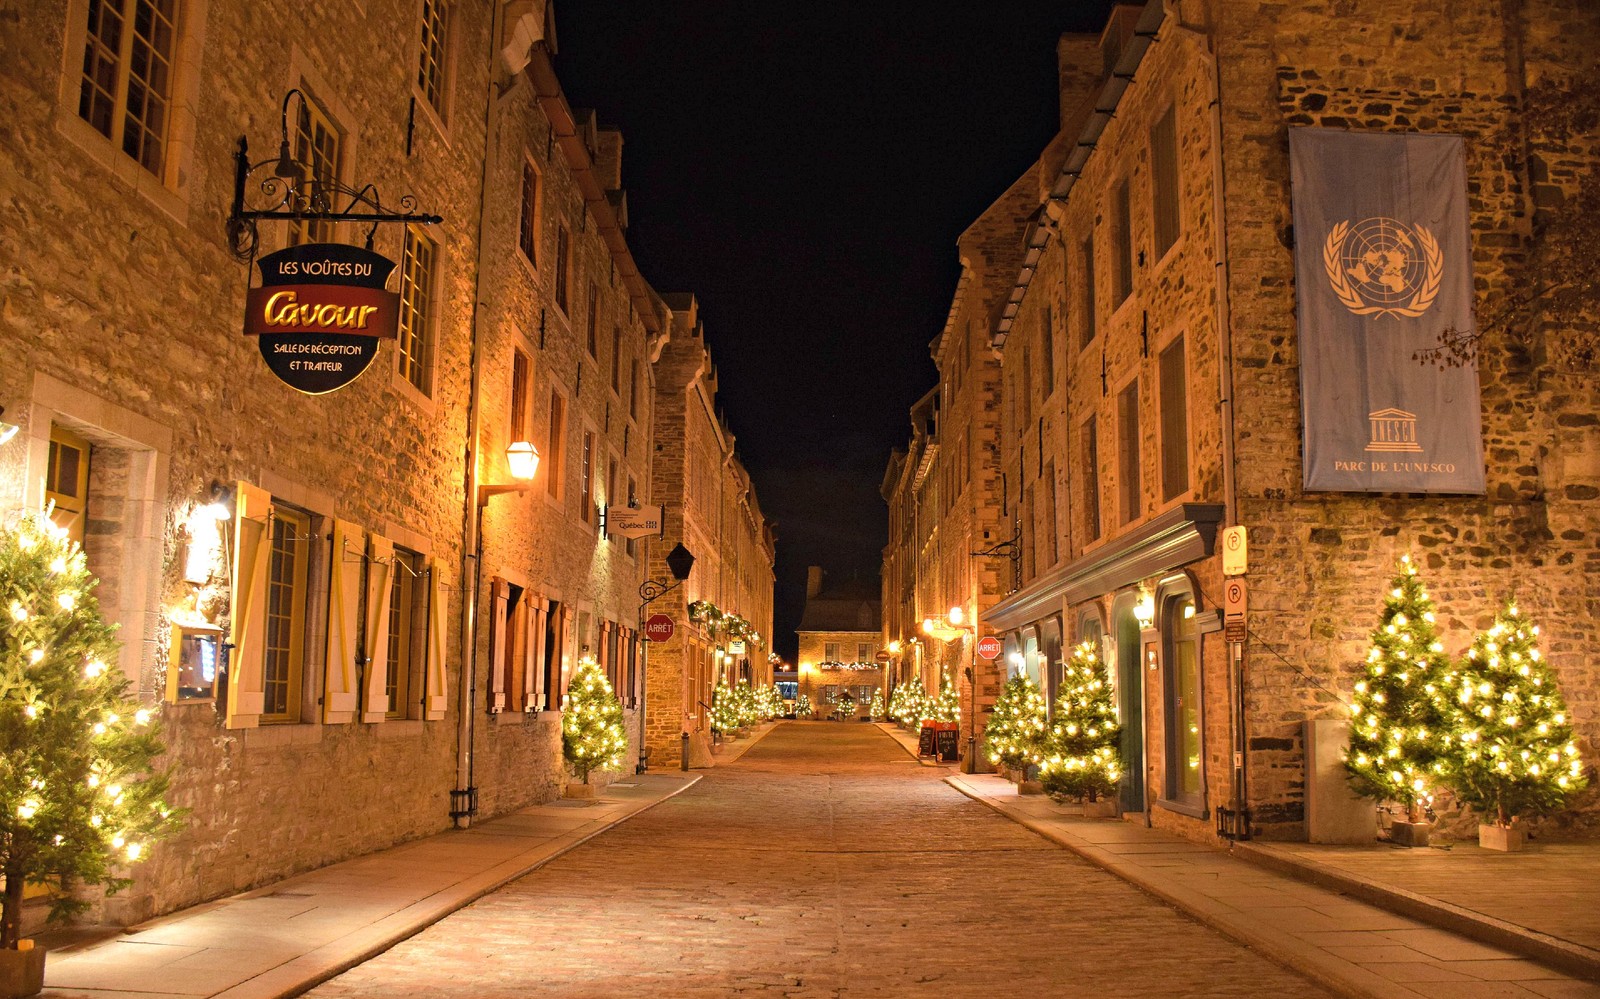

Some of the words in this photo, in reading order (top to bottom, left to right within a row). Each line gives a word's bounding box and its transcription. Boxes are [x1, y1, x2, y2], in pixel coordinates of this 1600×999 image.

[279, 262, 298, 275] LES
[301, 259, 352, 276] VOÛTES
[354, 264, 372, 276] DU
[264, 291, 378, 329] Cavour
[274, 343, 297, 354] SALLE
[298, 344, 310, 354] DE
[311, 342, 362, 355] RÉCEPTION
[289, 361, 301, 370] ET
[303, 361, 343, 372] TRAITEUR
[1371, 420, 1415, 442] UNESCO
[1335, 461, 1366, 471] PARC
[1371, 462, 1388, 472] DE
[1393, 462, 1455, 473] L'UNESCO
[619, 522, 645, 530] Québec
